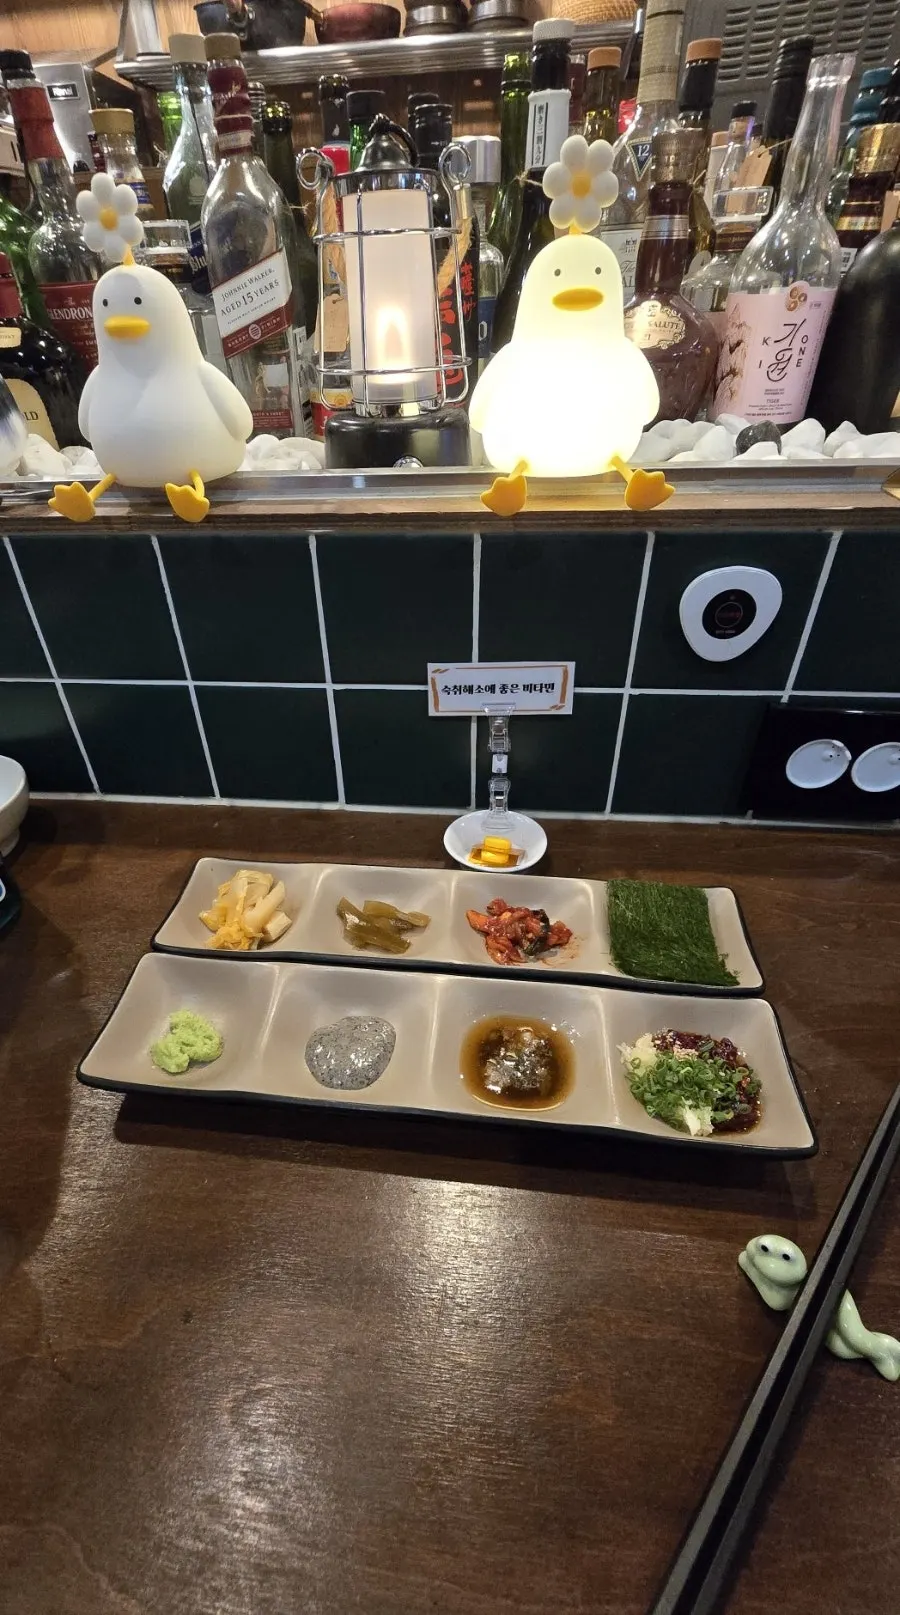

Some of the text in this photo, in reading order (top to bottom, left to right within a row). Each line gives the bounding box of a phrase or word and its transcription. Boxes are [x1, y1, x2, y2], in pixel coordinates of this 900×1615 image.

[637, 144, 650, 157] 12
[220, 279, 280, 316] AGED 15 YEARS
[221, 281, 248, 302] JOHNNIE
[48, 306, 94, 320] LENDRON
[441, 682, 555, 695] 숙취해소에 좋은 비타민
